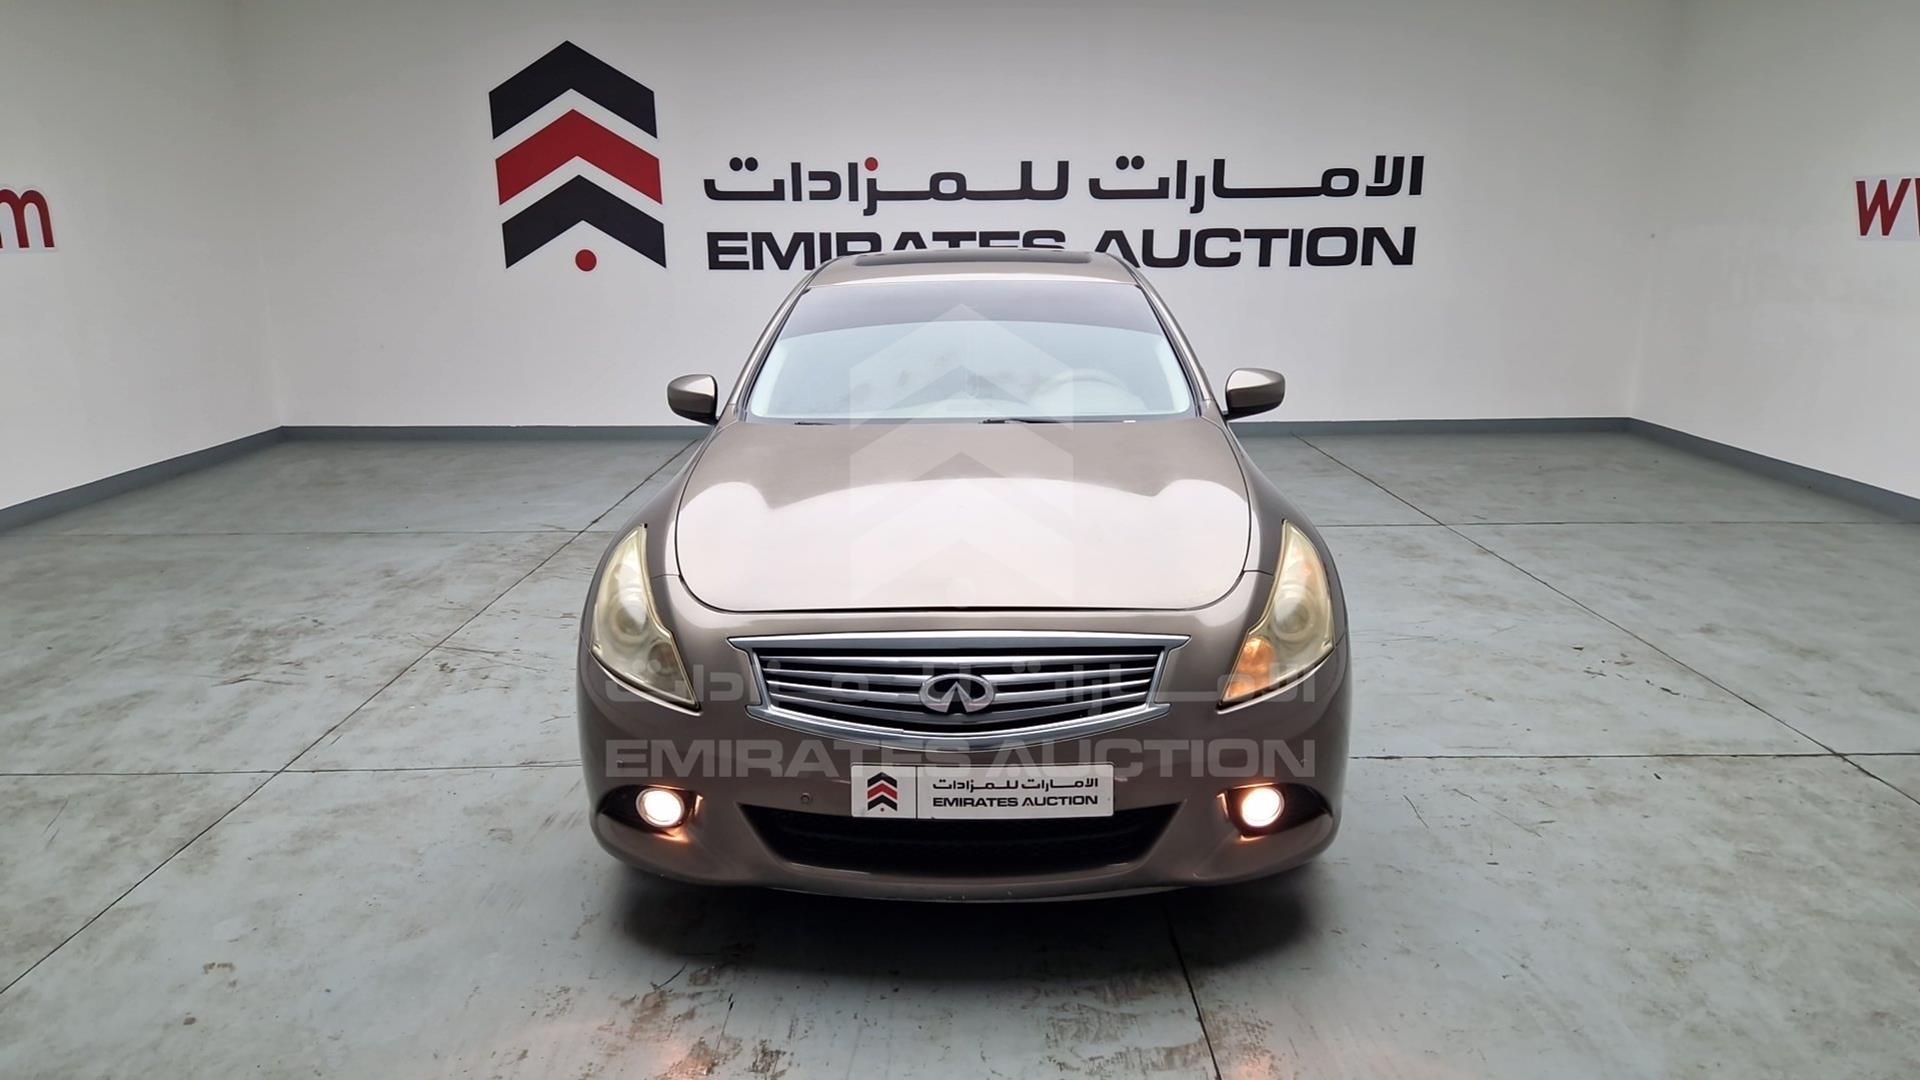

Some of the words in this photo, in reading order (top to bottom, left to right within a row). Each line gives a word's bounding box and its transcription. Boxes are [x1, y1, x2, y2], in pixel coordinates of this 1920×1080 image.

[703, 156, 1070, 216] للمزادات
[1095, 226, 1416, 268] AUCTION
[932, 778, 1019, 793] للمزادات
[932, 797, 1019, 808] EMIRATES
[1022, 795, 1098, 806] AUCTION
